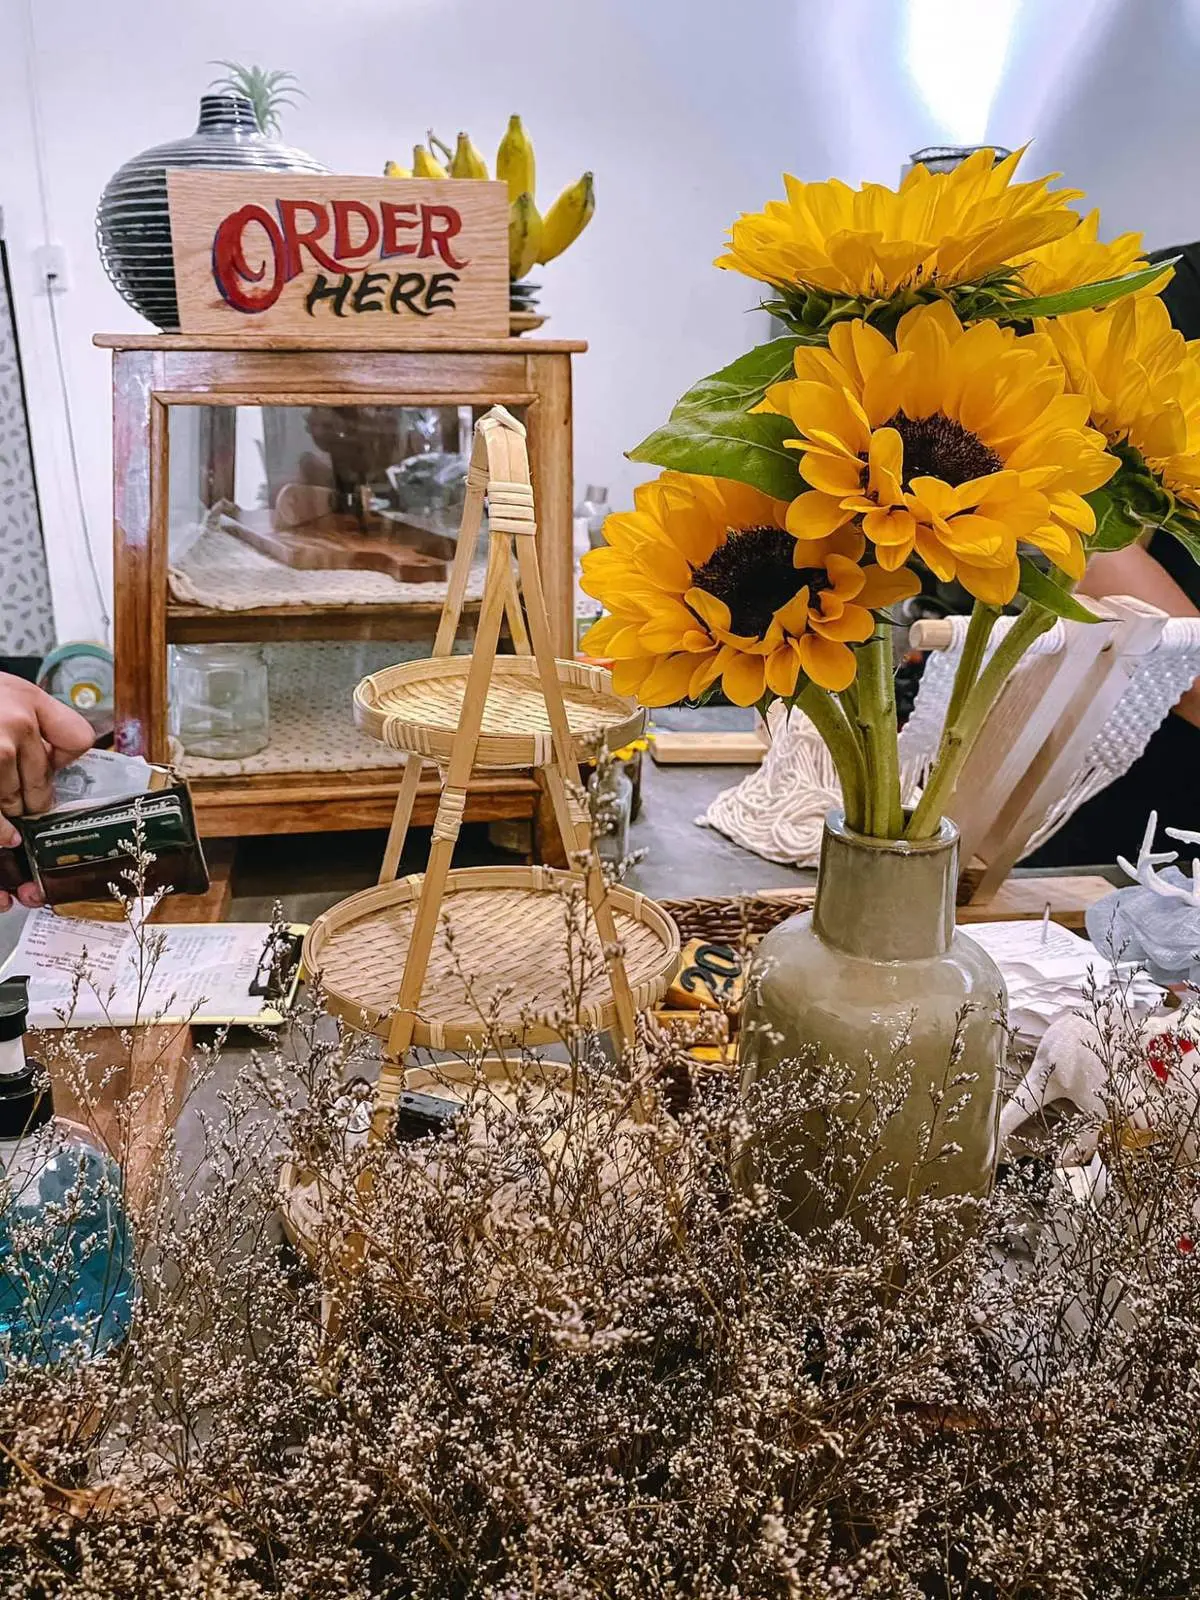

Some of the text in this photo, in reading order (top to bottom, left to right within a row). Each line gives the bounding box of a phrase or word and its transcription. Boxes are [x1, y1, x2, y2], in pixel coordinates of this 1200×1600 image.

[211, 199, 471, 313] ORDER
[306, 272, 460, 317] HERE
[680, 943, 742, 1002] 20
